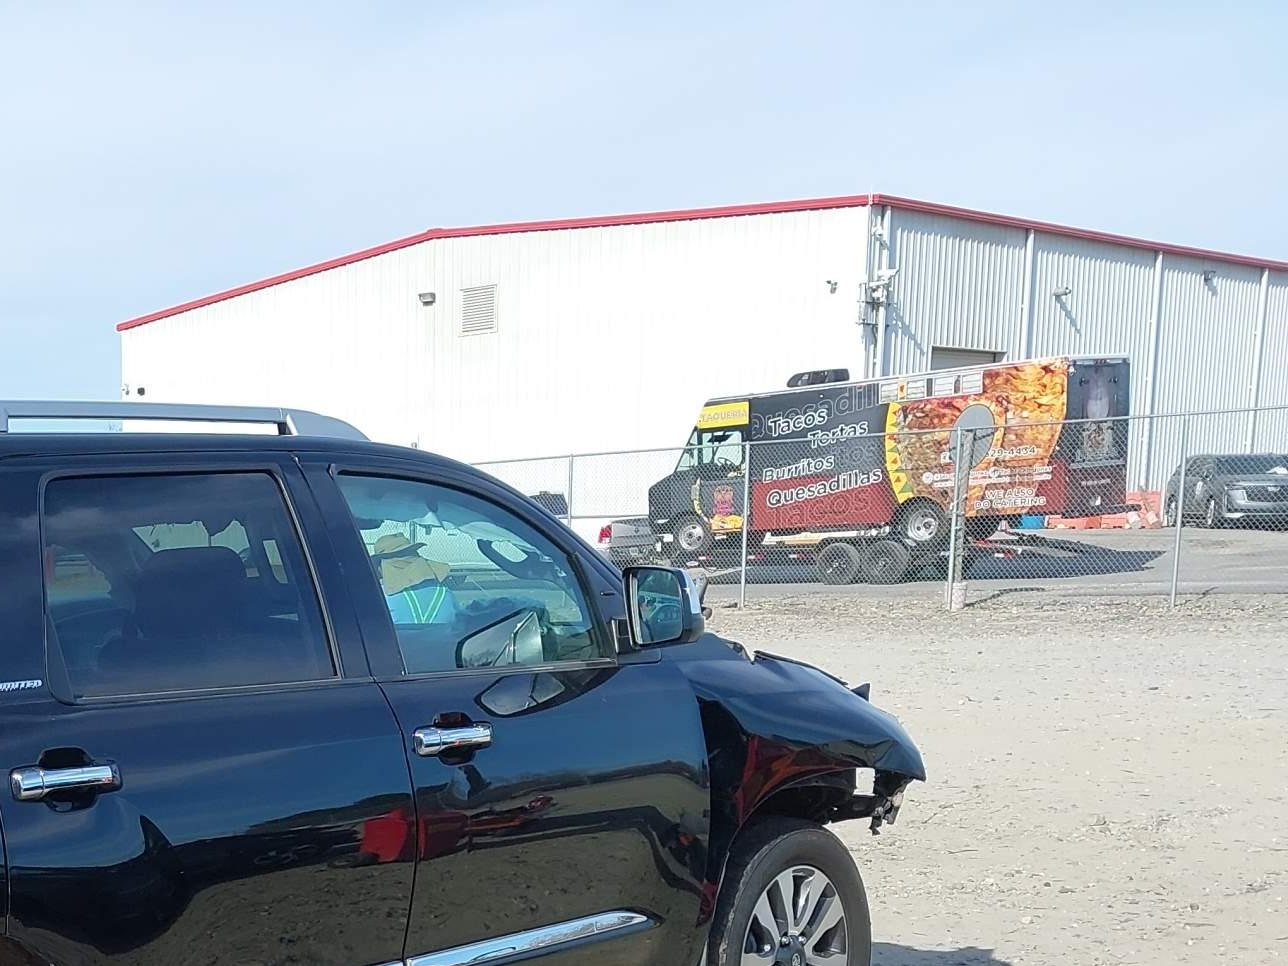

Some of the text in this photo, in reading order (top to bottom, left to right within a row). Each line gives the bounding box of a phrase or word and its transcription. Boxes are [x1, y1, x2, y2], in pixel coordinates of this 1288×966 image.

[768, 408, 828, 437] Tacos
[808, 421, 869, 448] Tortas
[762, 454, 835, 483] Burritos
[767, 467, 883, 508] Quesadillas
[985, 487, 1035, 499] WE ALSO
[975, 496, 1047, 509] DO CATERING
